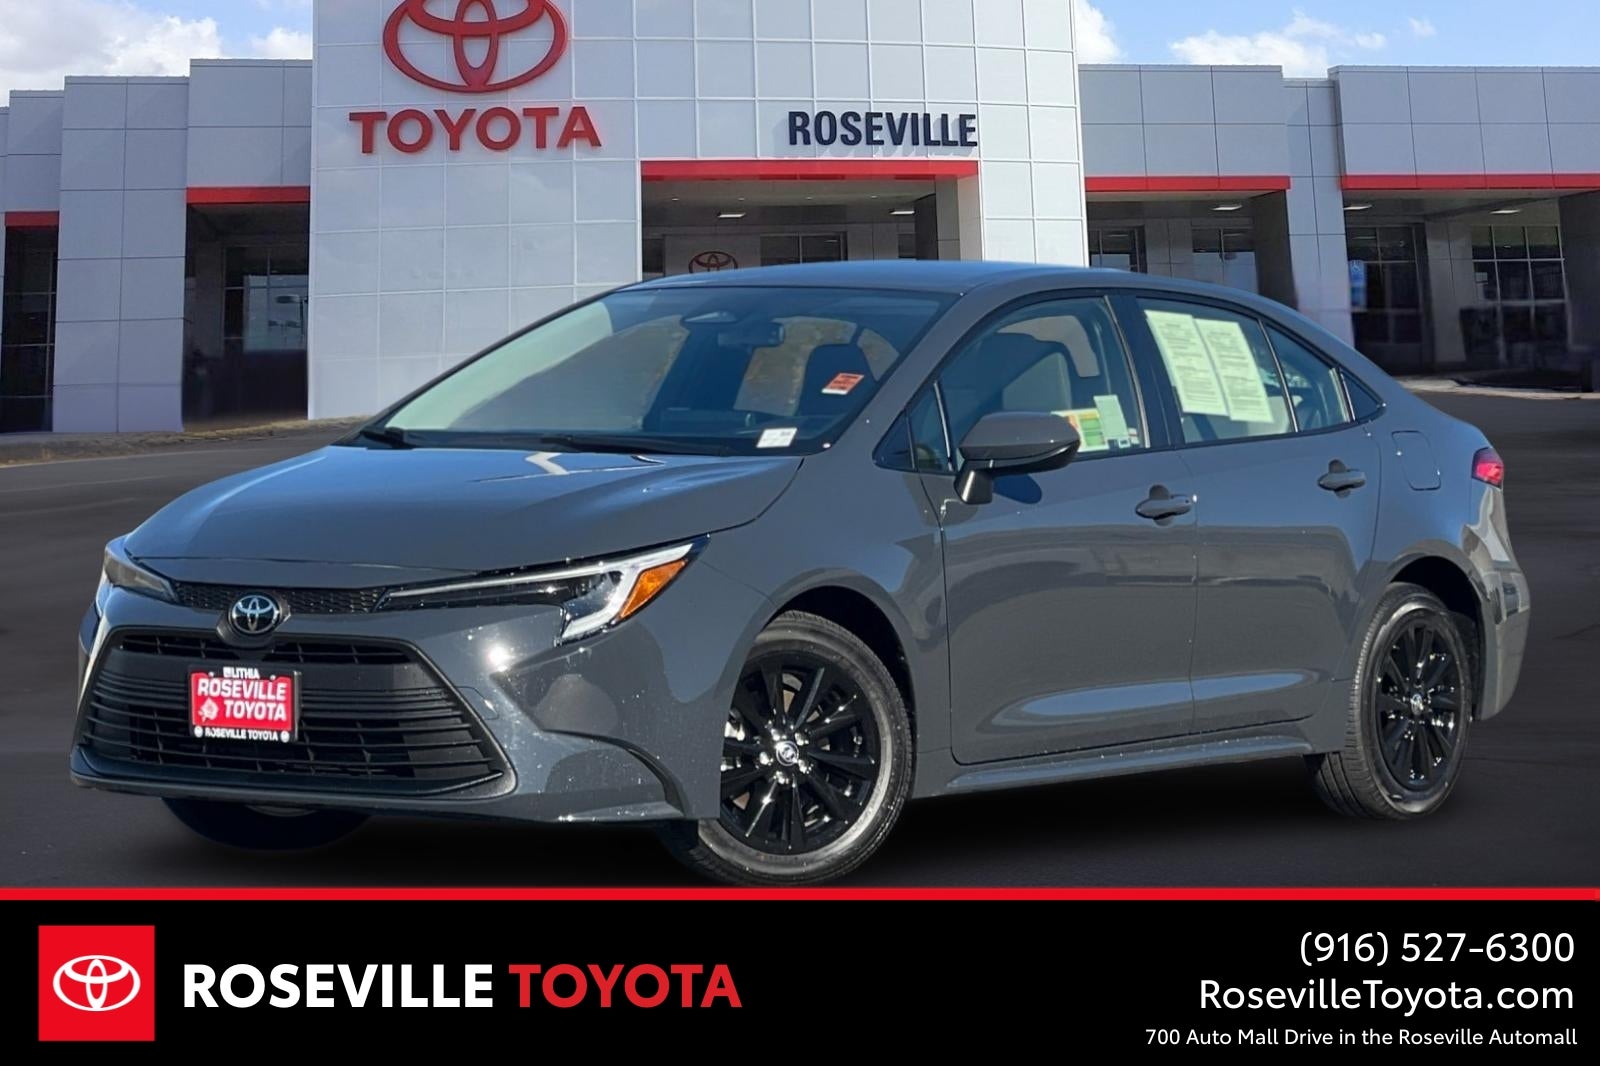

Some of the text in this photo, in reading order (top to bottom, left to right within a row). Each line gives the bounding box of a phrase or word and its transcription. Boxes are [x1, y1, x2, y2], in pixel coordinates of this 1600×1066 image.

[350, 106, 602, 154] TOYOTA
[788, 111, 979, 147] ROSEVILLE
[232, 667, 260, 679] LITHIA
[197, 679, 287, 701] ROSEVILLE
[224, 700, 287, 722] TOYOTA
[204, 727, 279, 742] ROSEVILLE TOYOTA
